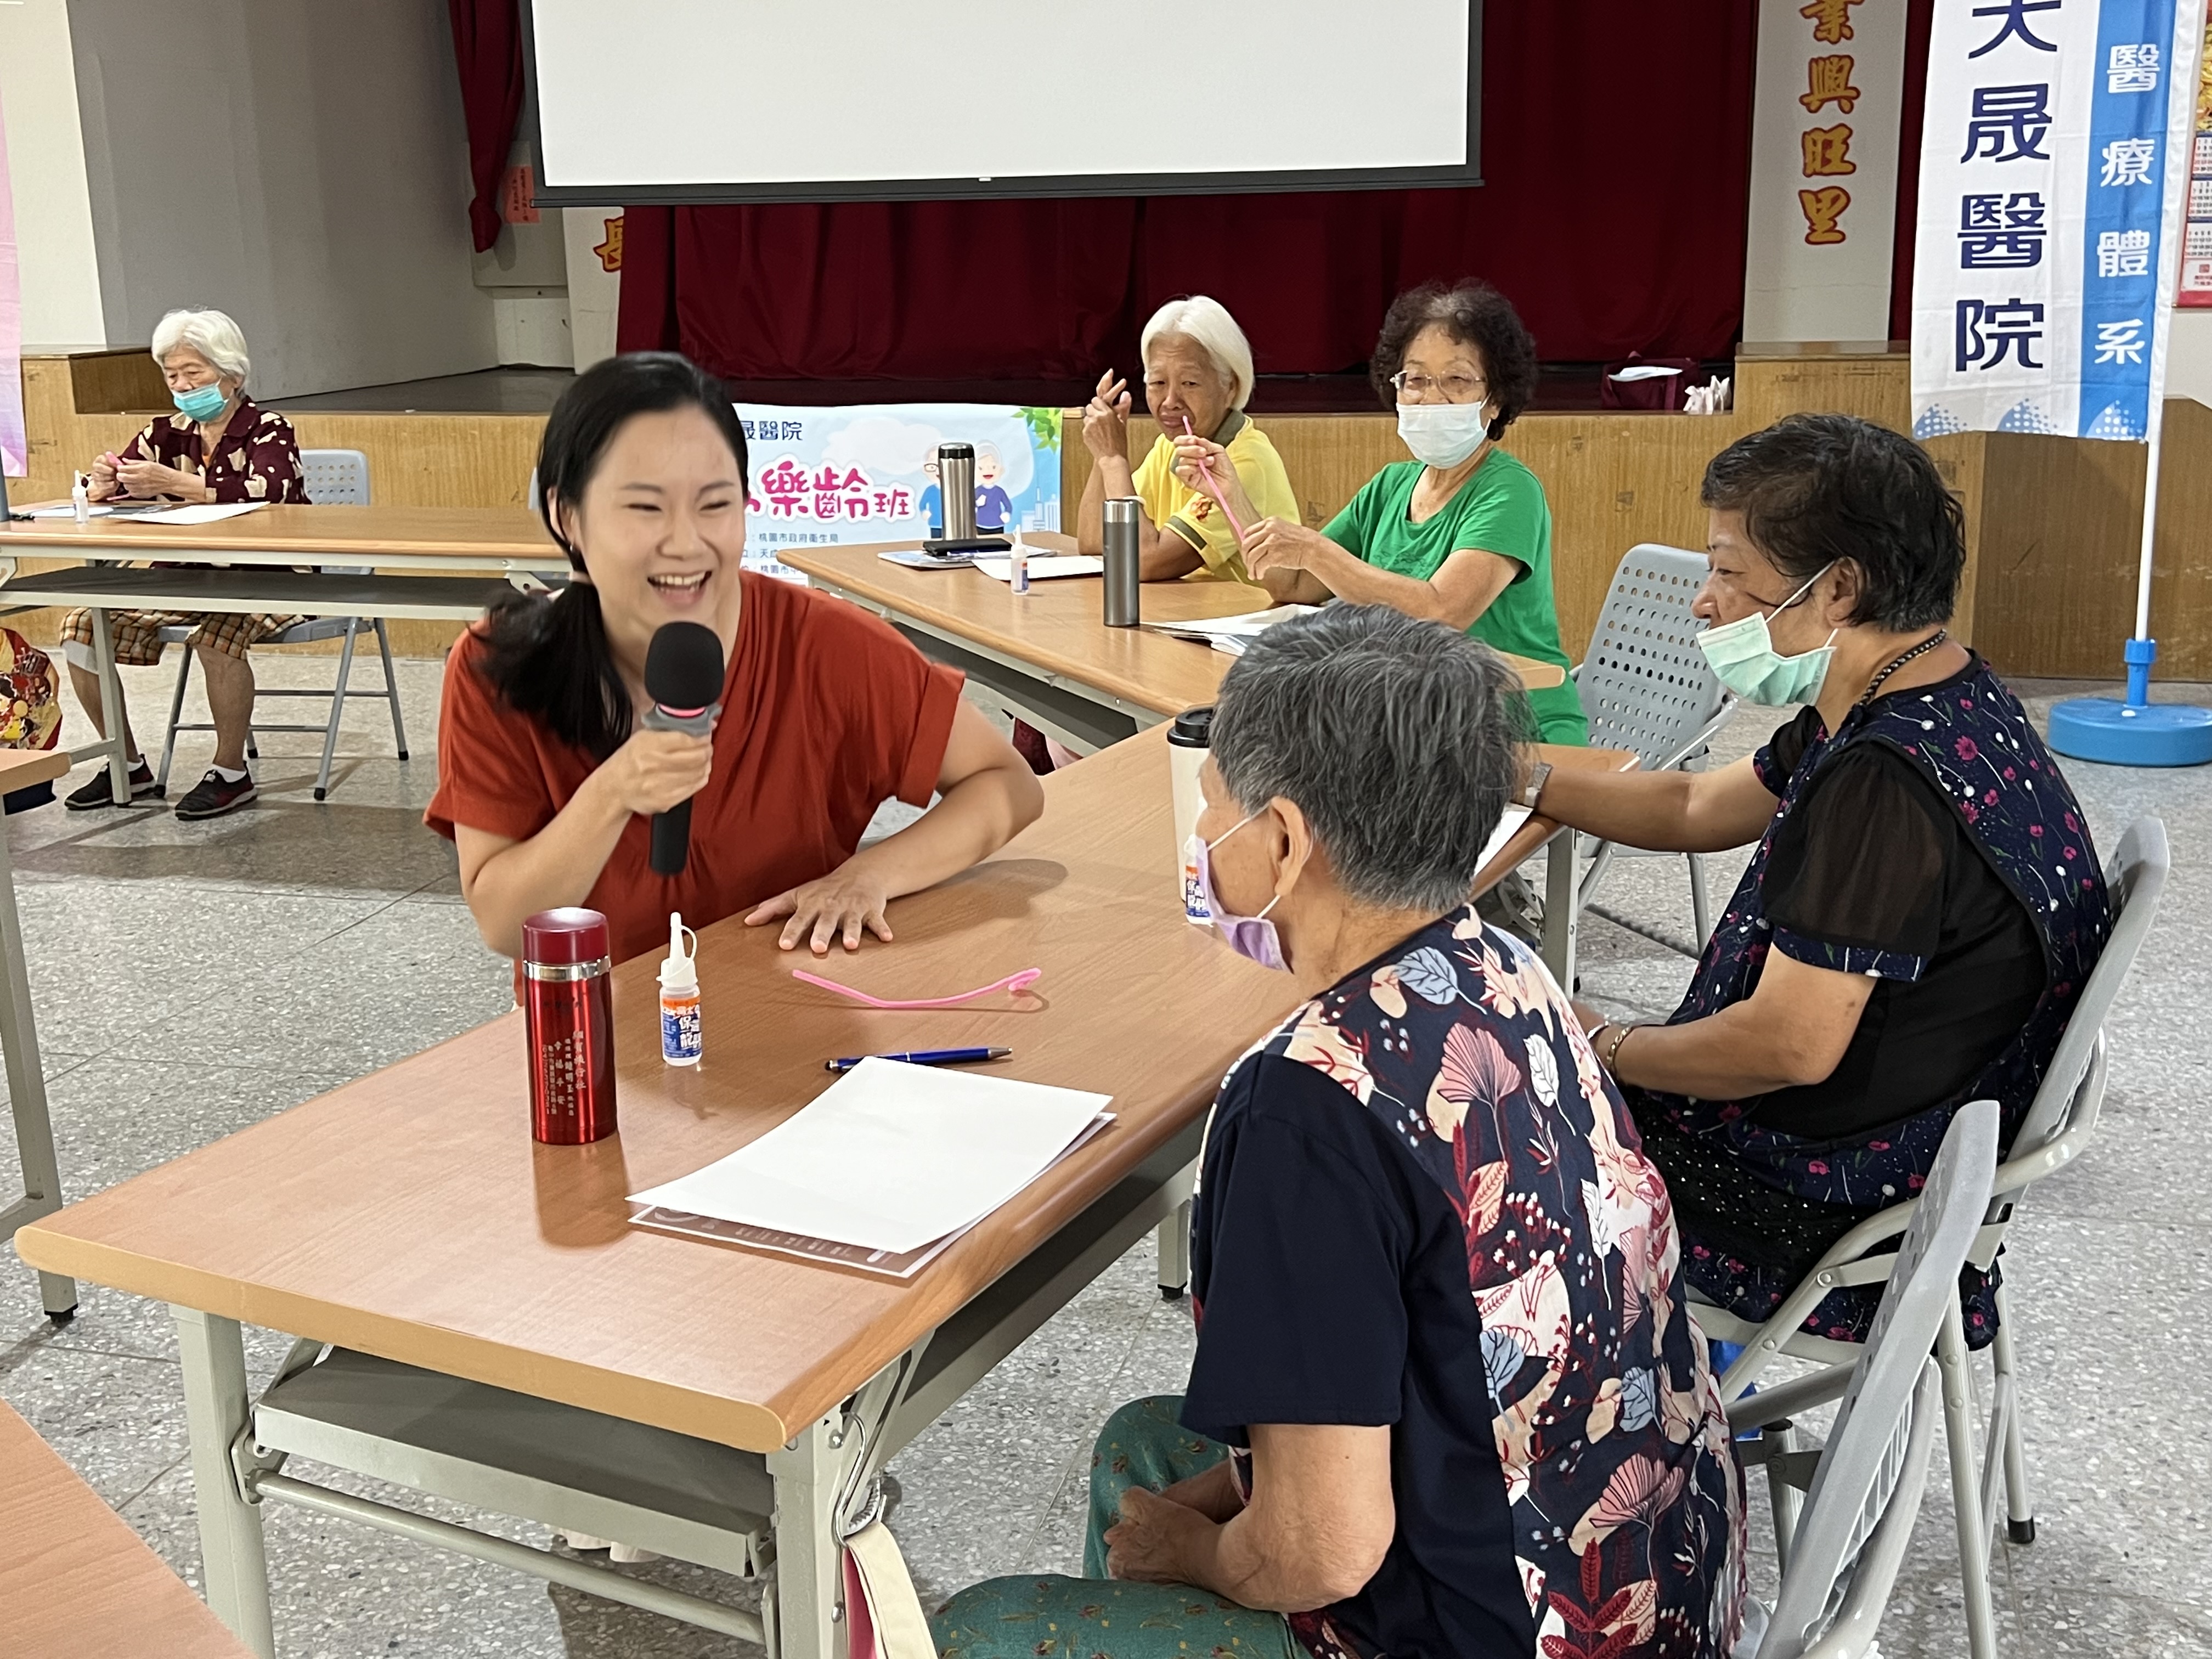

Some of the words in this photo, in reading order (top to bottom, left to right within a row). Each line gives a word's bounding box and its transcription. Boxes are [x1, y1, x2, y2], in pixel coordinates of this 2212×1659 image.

[2094, 43, 2160, 365] 醫療體系
[748, 461, 910, 518] 樂齡班
